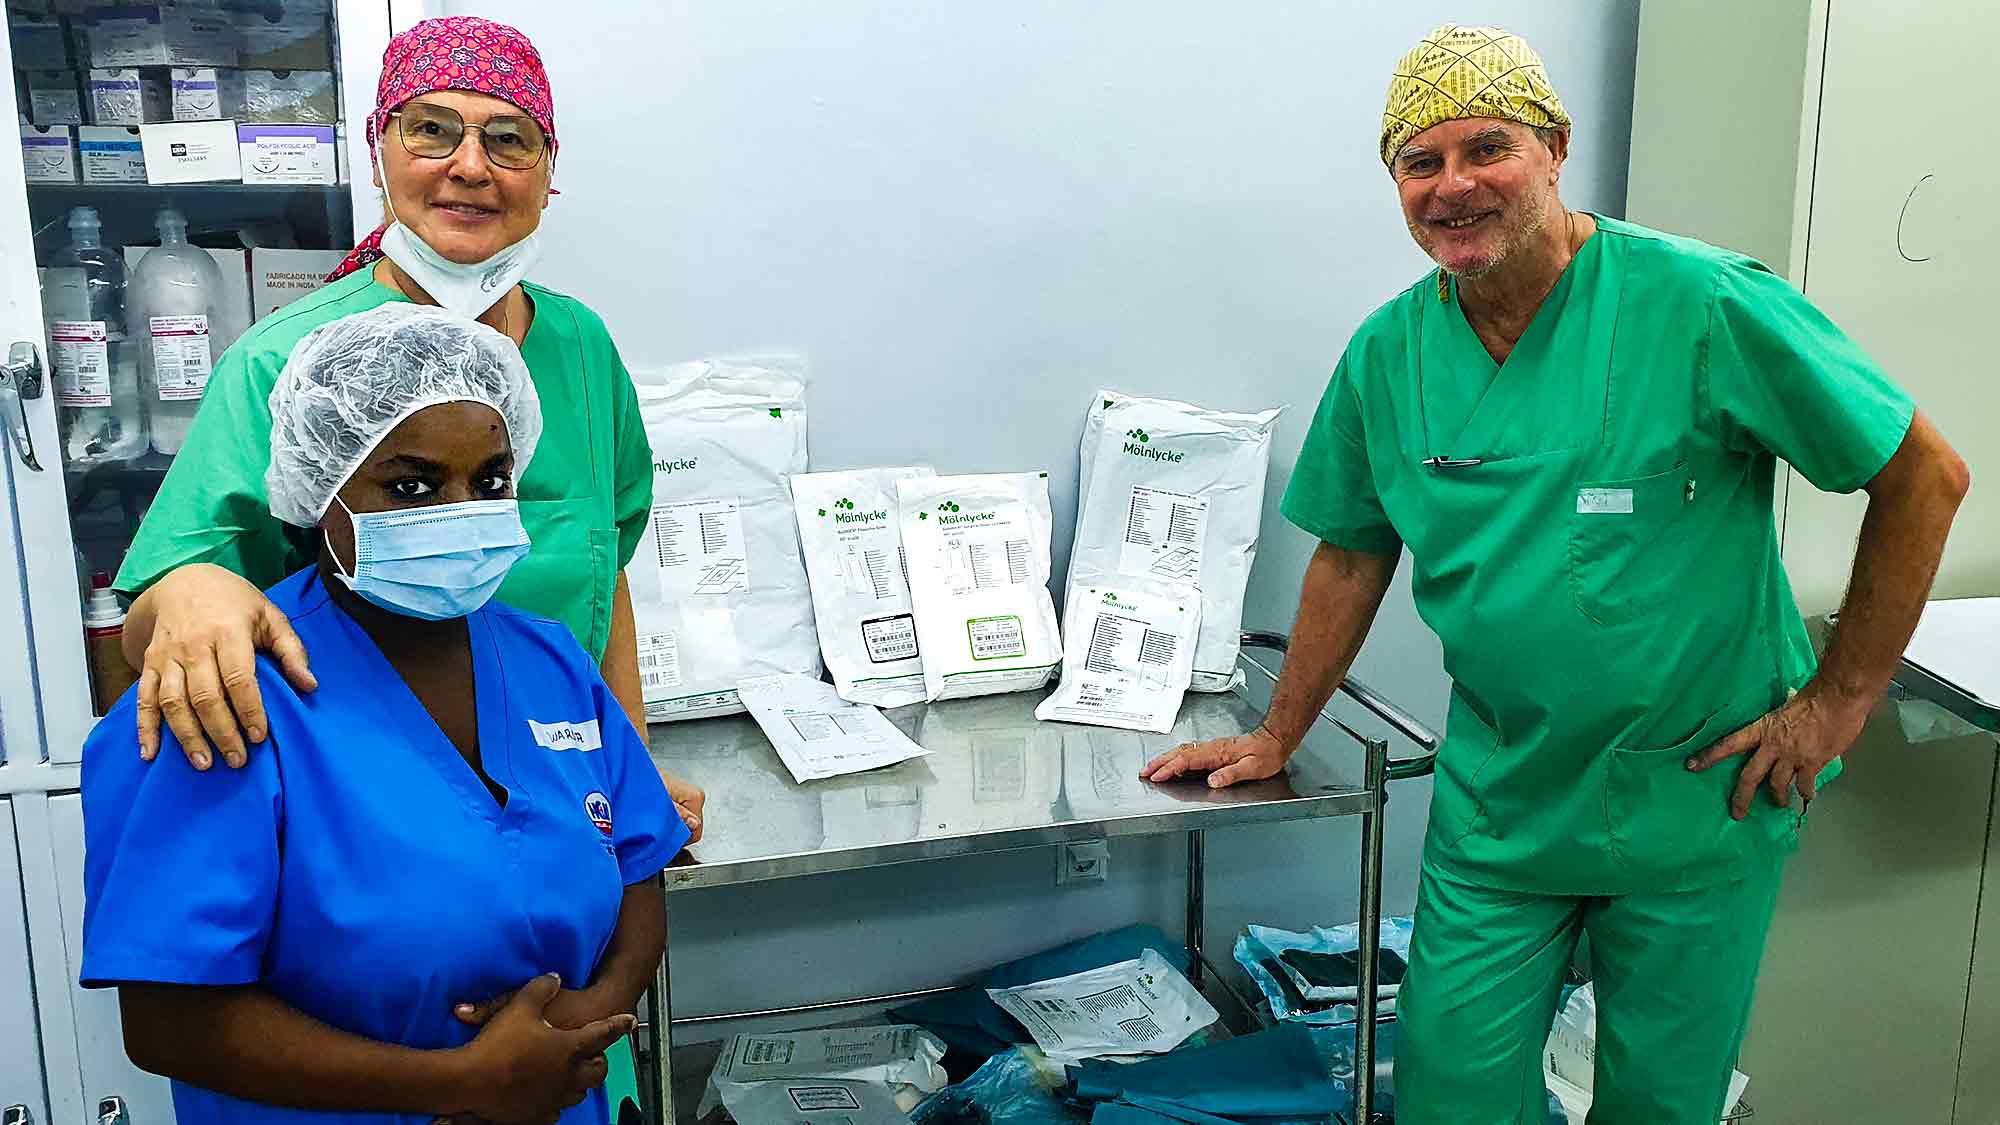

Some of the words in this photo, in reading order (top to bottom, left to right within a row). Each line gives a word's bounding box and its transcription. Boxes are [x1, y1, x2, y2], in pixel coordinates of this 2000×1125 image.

[1123, 442, 1183, 463] Mölnlycke
[654, 458, 697, 474] nlycke
[835, 510, 887, 524] Mölnlycke
[939, 512, 995, 525] Mölnlycke
